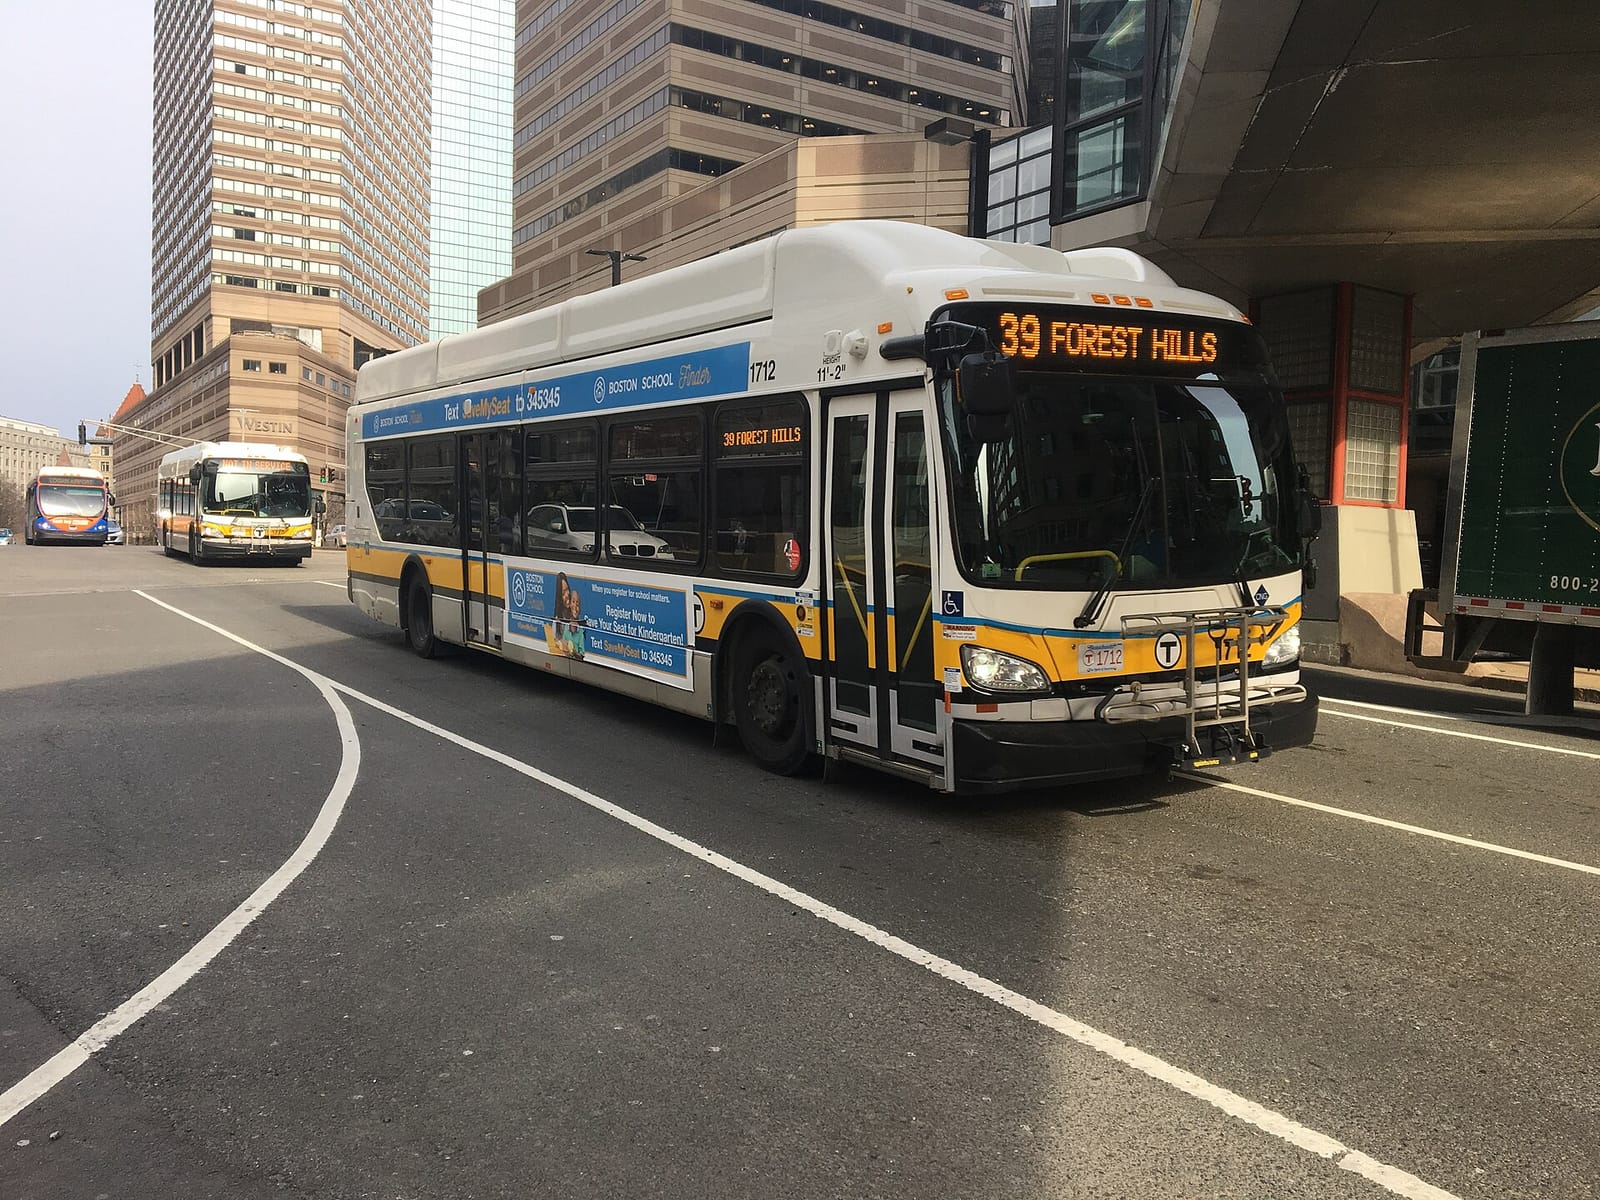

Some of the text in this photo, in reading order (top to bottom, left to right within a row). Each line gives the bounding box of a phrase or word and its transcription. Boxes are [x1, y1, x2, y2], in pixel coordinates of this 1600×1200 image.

[1000, 311, 1218, 362] 39 FOREST HILLS
[822, 355, 841, 364] HEIGHT
[608, 364, 712, 394] BOSTON SCHOOL Finder
[750, 360, 776, 382] 1712
[817, 364, 846, 382] 11'-2"
[444, 403, 459, 421] Text
[527, 387, 560, 411] 345345
[236, 417, 293, 433] WESTIN
[723, 427, 801, 446] 39 FOREST HILLS
[255, 461, 292, 472] SERVICE
[526, 583, 544, 595] SCHOOL
[591, 583, 603, 593] When
[603, 588, 611, 596] you
[612, 588, 628, 597] register
[635, 591, 651, 600] school
[1550, 575, 1599, 593] 800-2
[605, 604, 656, 624] Register Now to
[583, 614, 684, 646] Save Your Seat for Kindergarten!
[590, 636, 673, 667] Text SaveMySeat to 345345
[1096, 649, 1122, 666] 1712
[1160, 641, 1177, 663] T
